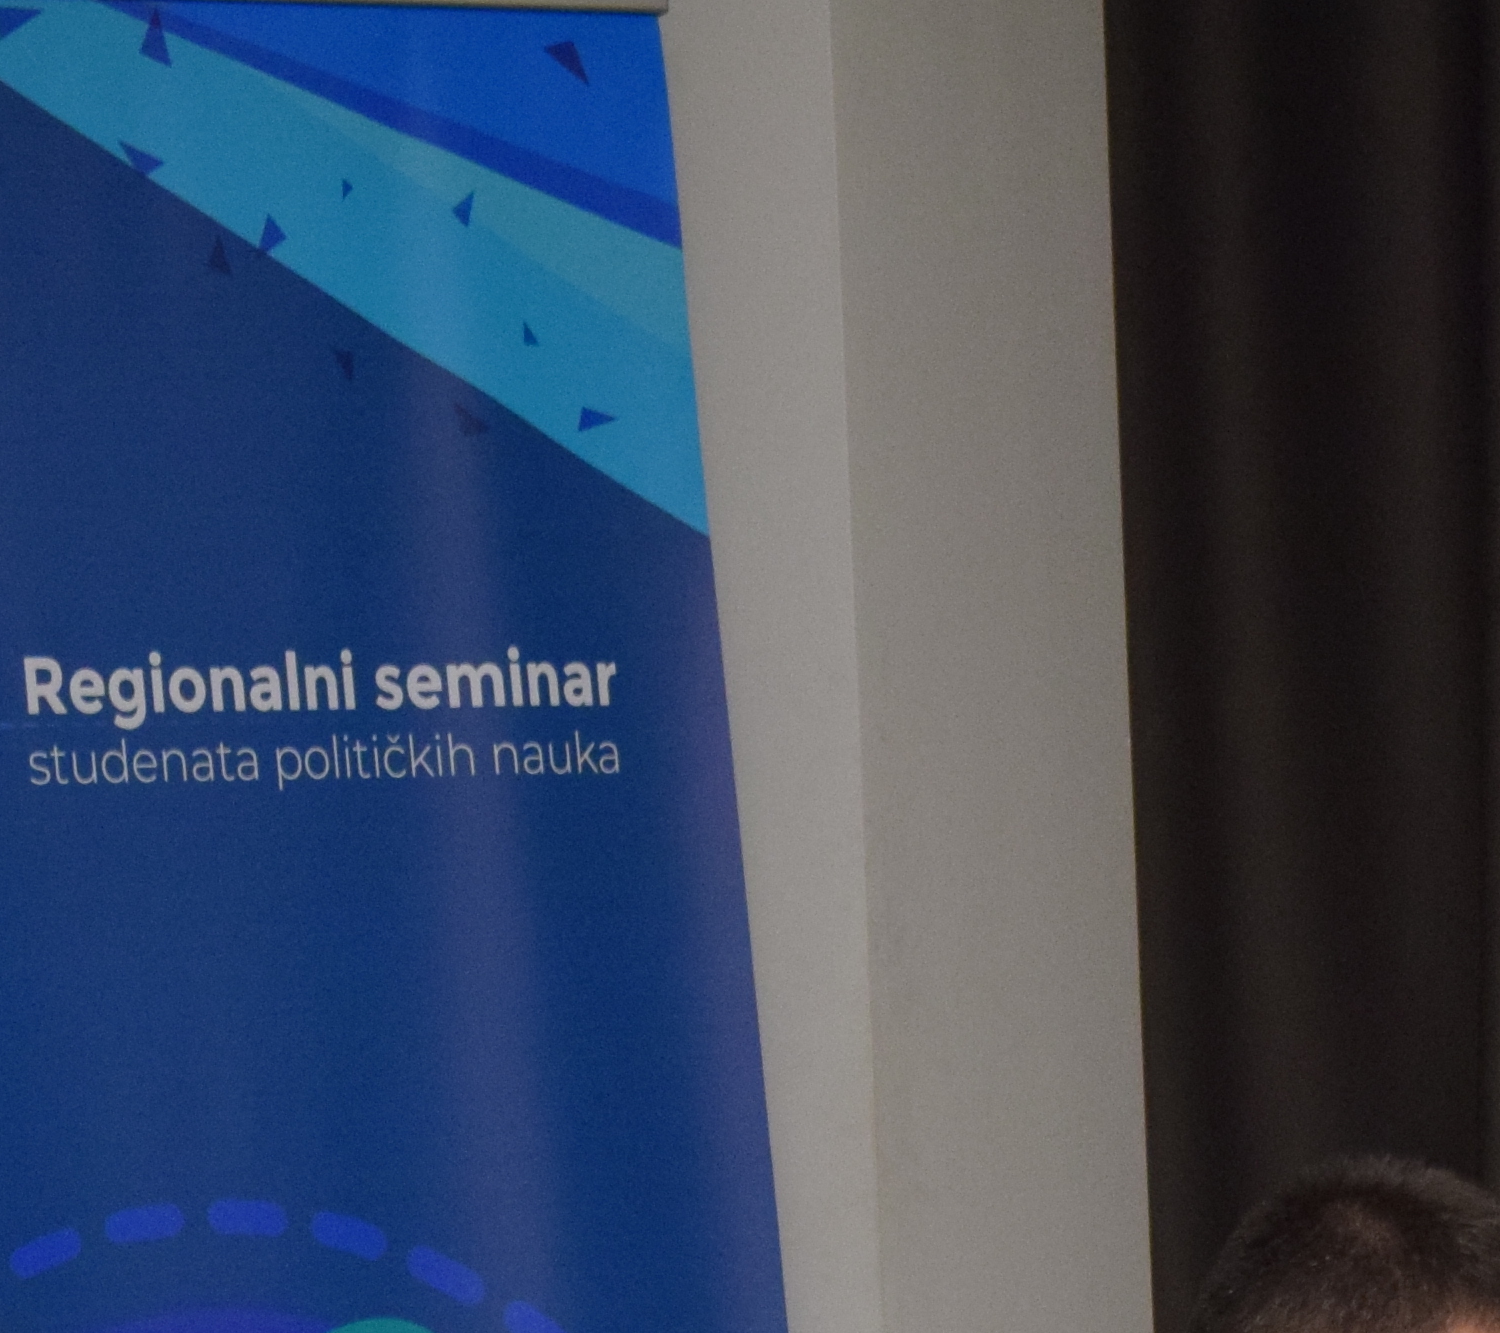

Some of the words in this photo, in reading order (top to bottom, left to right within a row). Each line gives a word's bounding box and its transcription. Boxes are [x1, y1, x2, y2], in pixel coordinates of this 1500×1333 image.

[23, 648, 356, 730] Regionalni
[375, 645, 617, 711] seminar
[28, 736, 260, 787] studenata
[276, 732, 476, 791] političkih
[492, 730, 621, 780] nauka
